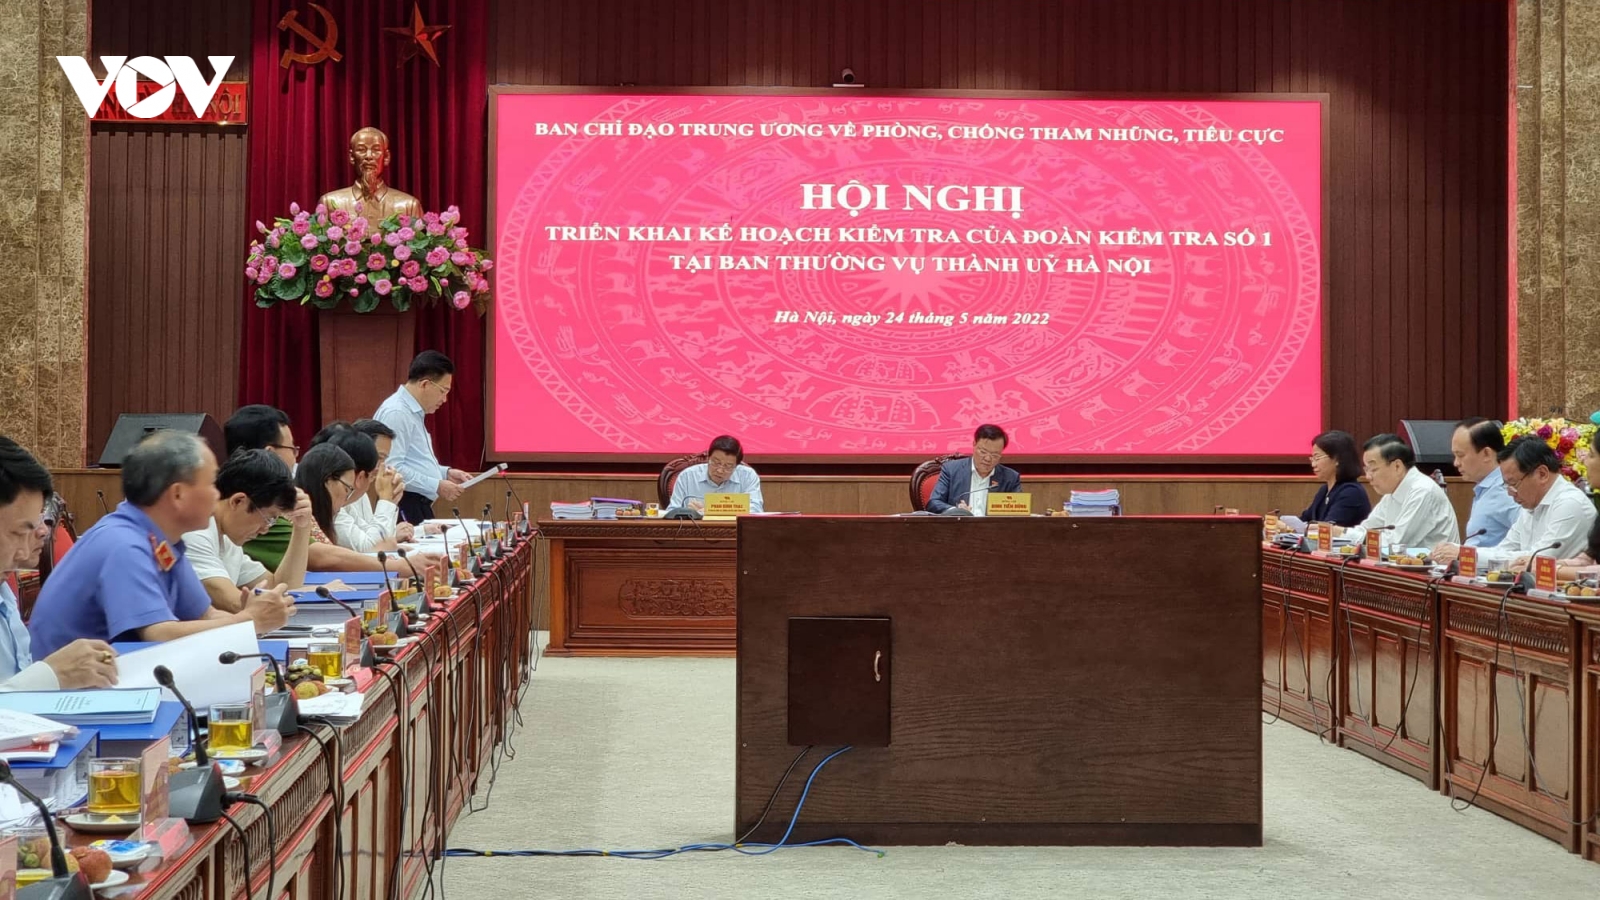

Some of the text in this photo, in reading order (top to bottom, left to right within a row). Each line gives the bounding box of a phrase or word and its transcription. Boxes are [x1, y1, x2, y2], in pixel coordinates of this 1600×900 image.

[535, 119, 1284, 146] BAN CHỈ ĐẠO TRUNG ƯƠNG VỀ PHÒNG, CHỐNG THAM NHŨNG, TIÊU CỰC
[799, 179, 1025, 220] HỘI NGHỊ
[544, 222, 1271, 247] TRIỂN KHAI KẾ HOẠCH KIỂM TRA CỦA ĐOÀN KIỂM TRA SỐ 1
[668, 255, 712, 274] TẠI
[718, 255, 770, 270] BAN
[775, 251, 886, 271] THƯỜNG
[891, 256, 926, 276] VỤ
[931, 253, 1019, 273] THÀNH
[1065, 254, 1101, 273] HÀ
[1106, 256, 1152, 277] NỘI
[773, 310, 1051, 327] Hà Nội, ngày 24 tháng 5 năm 2022
